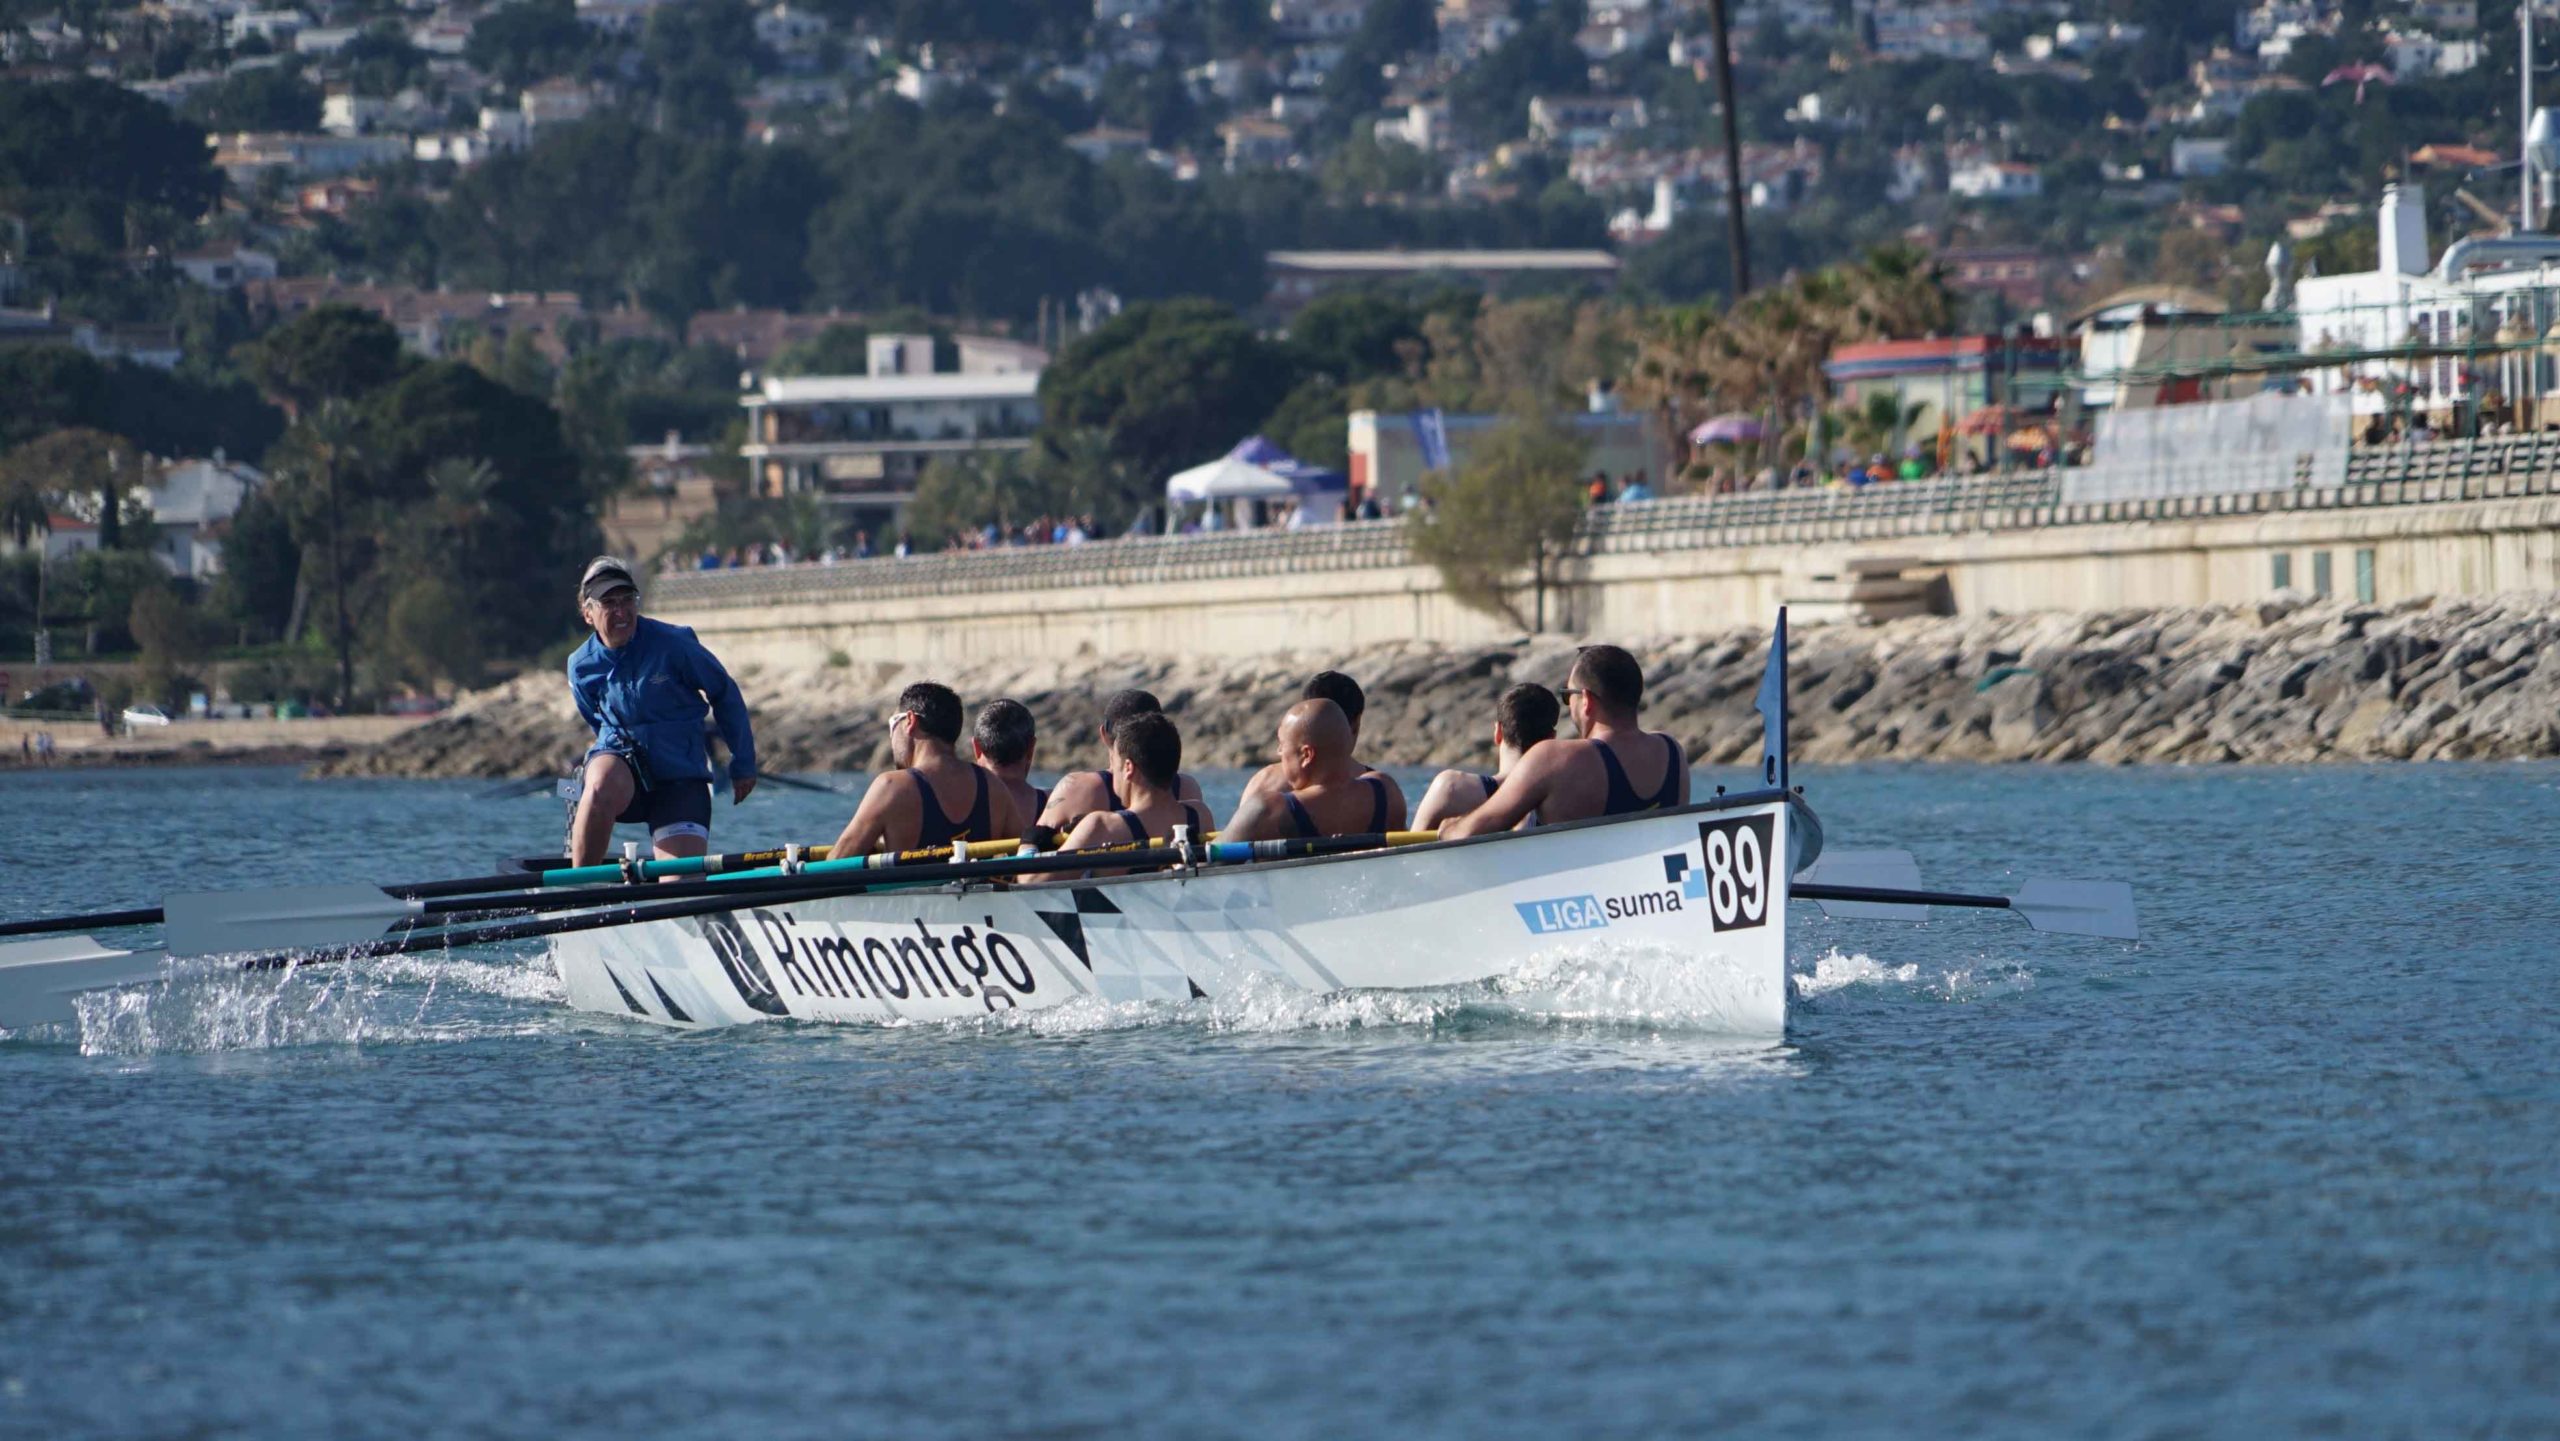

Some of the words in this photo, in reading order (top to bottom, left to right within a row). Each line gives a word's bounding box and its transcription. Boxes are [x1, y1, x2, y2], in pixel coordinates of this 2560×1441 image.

[1535, 900, 1604, 932] LIGA
[1605, 888, 1682, 919] suma
[1707, 825, 1765, 924] 89
